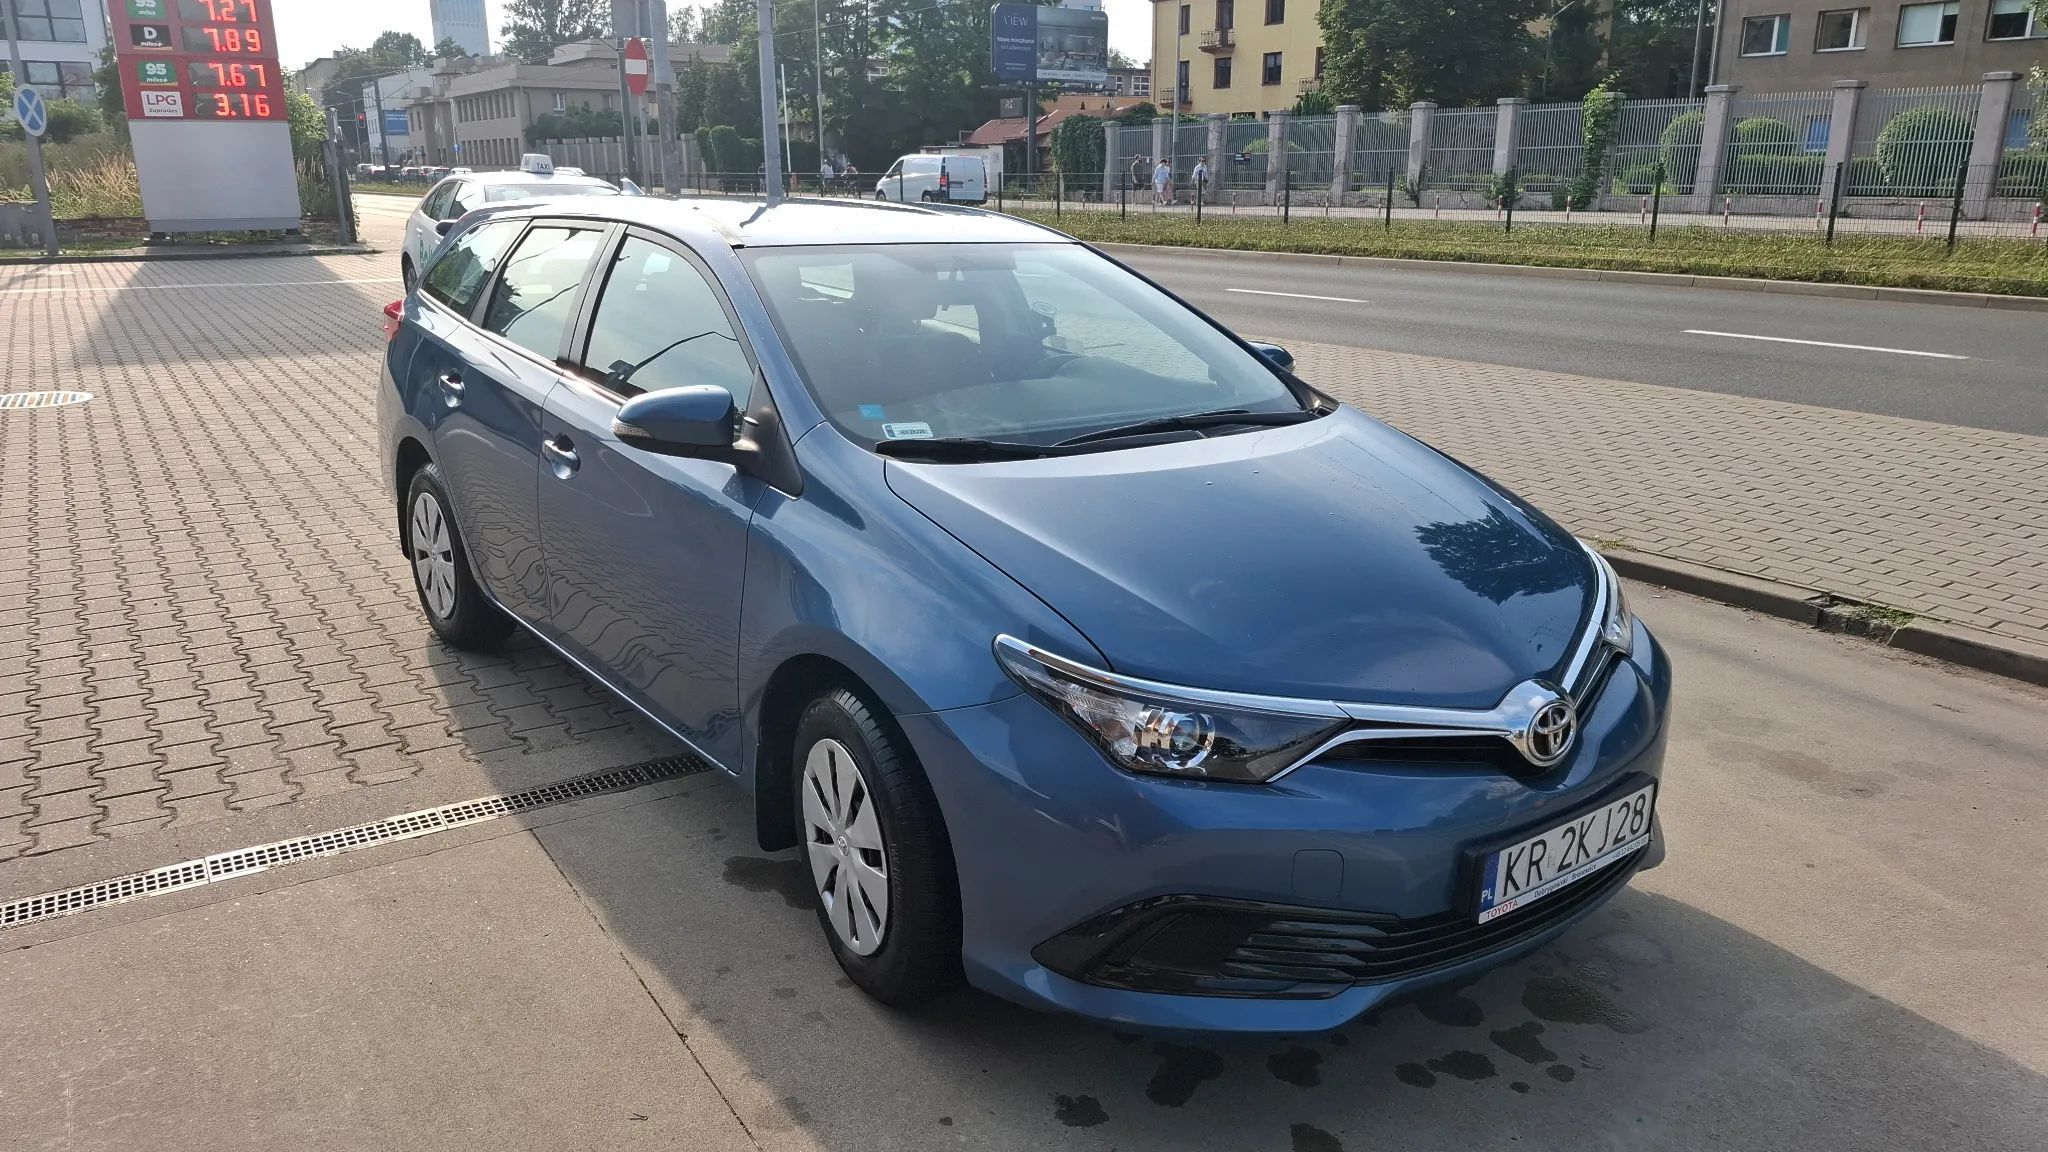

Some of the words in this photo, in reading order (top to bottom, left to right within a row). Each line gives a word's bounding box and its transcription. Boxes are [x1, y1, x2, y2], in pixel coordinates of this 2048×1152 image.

[202, 0, 258, 22] 7.27
[1003, 15, 1029, 27] VIEW
[143, 26, 157, 40] D
[203, 27, 262, 53] 7.89
[145, 62, 167, 76] 95
[208, 62, 267, 87] 7.67
[145, 94, 177, 106] LPG
[213, 93, 271, 117] 3.16
[536, 162, 551, 170] TAXI
[1502, 838, 1547, 897] KR
[1557, 793, 1647, 873] 2KJ28
[1481, 888, 1493, 903] PL
[1486, 899, 1519, 920] TOYOTA
